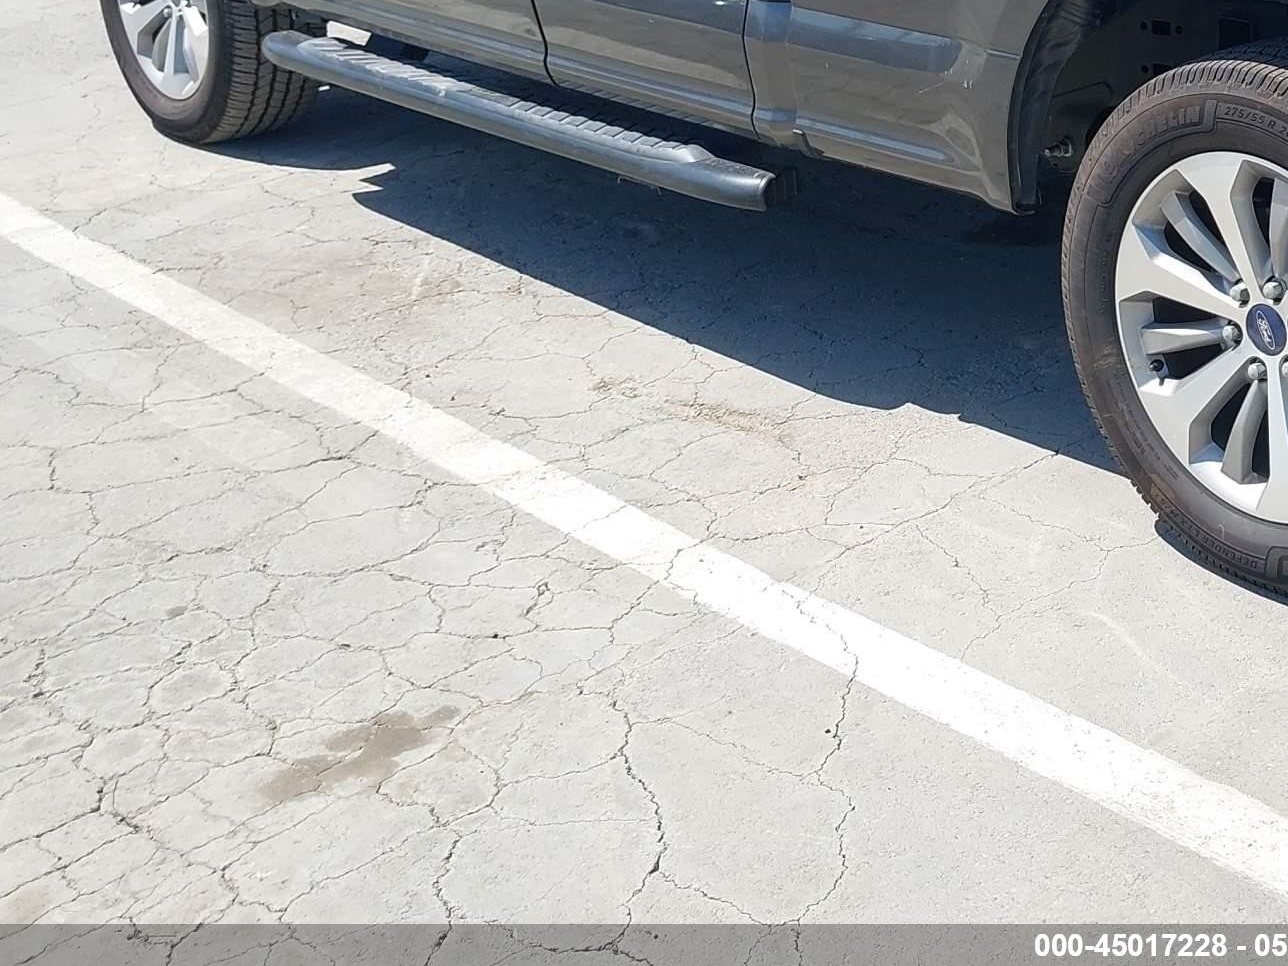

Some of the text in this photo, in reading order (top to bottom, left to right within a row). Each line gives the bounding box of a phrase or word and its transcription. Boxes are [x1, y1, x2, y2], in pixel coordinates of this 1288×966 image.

[1224, 106, 1265, 126] 275/55
[1267, 119, 1278, 131] R
[1201, 535, 1258, 570] DEFENDER
